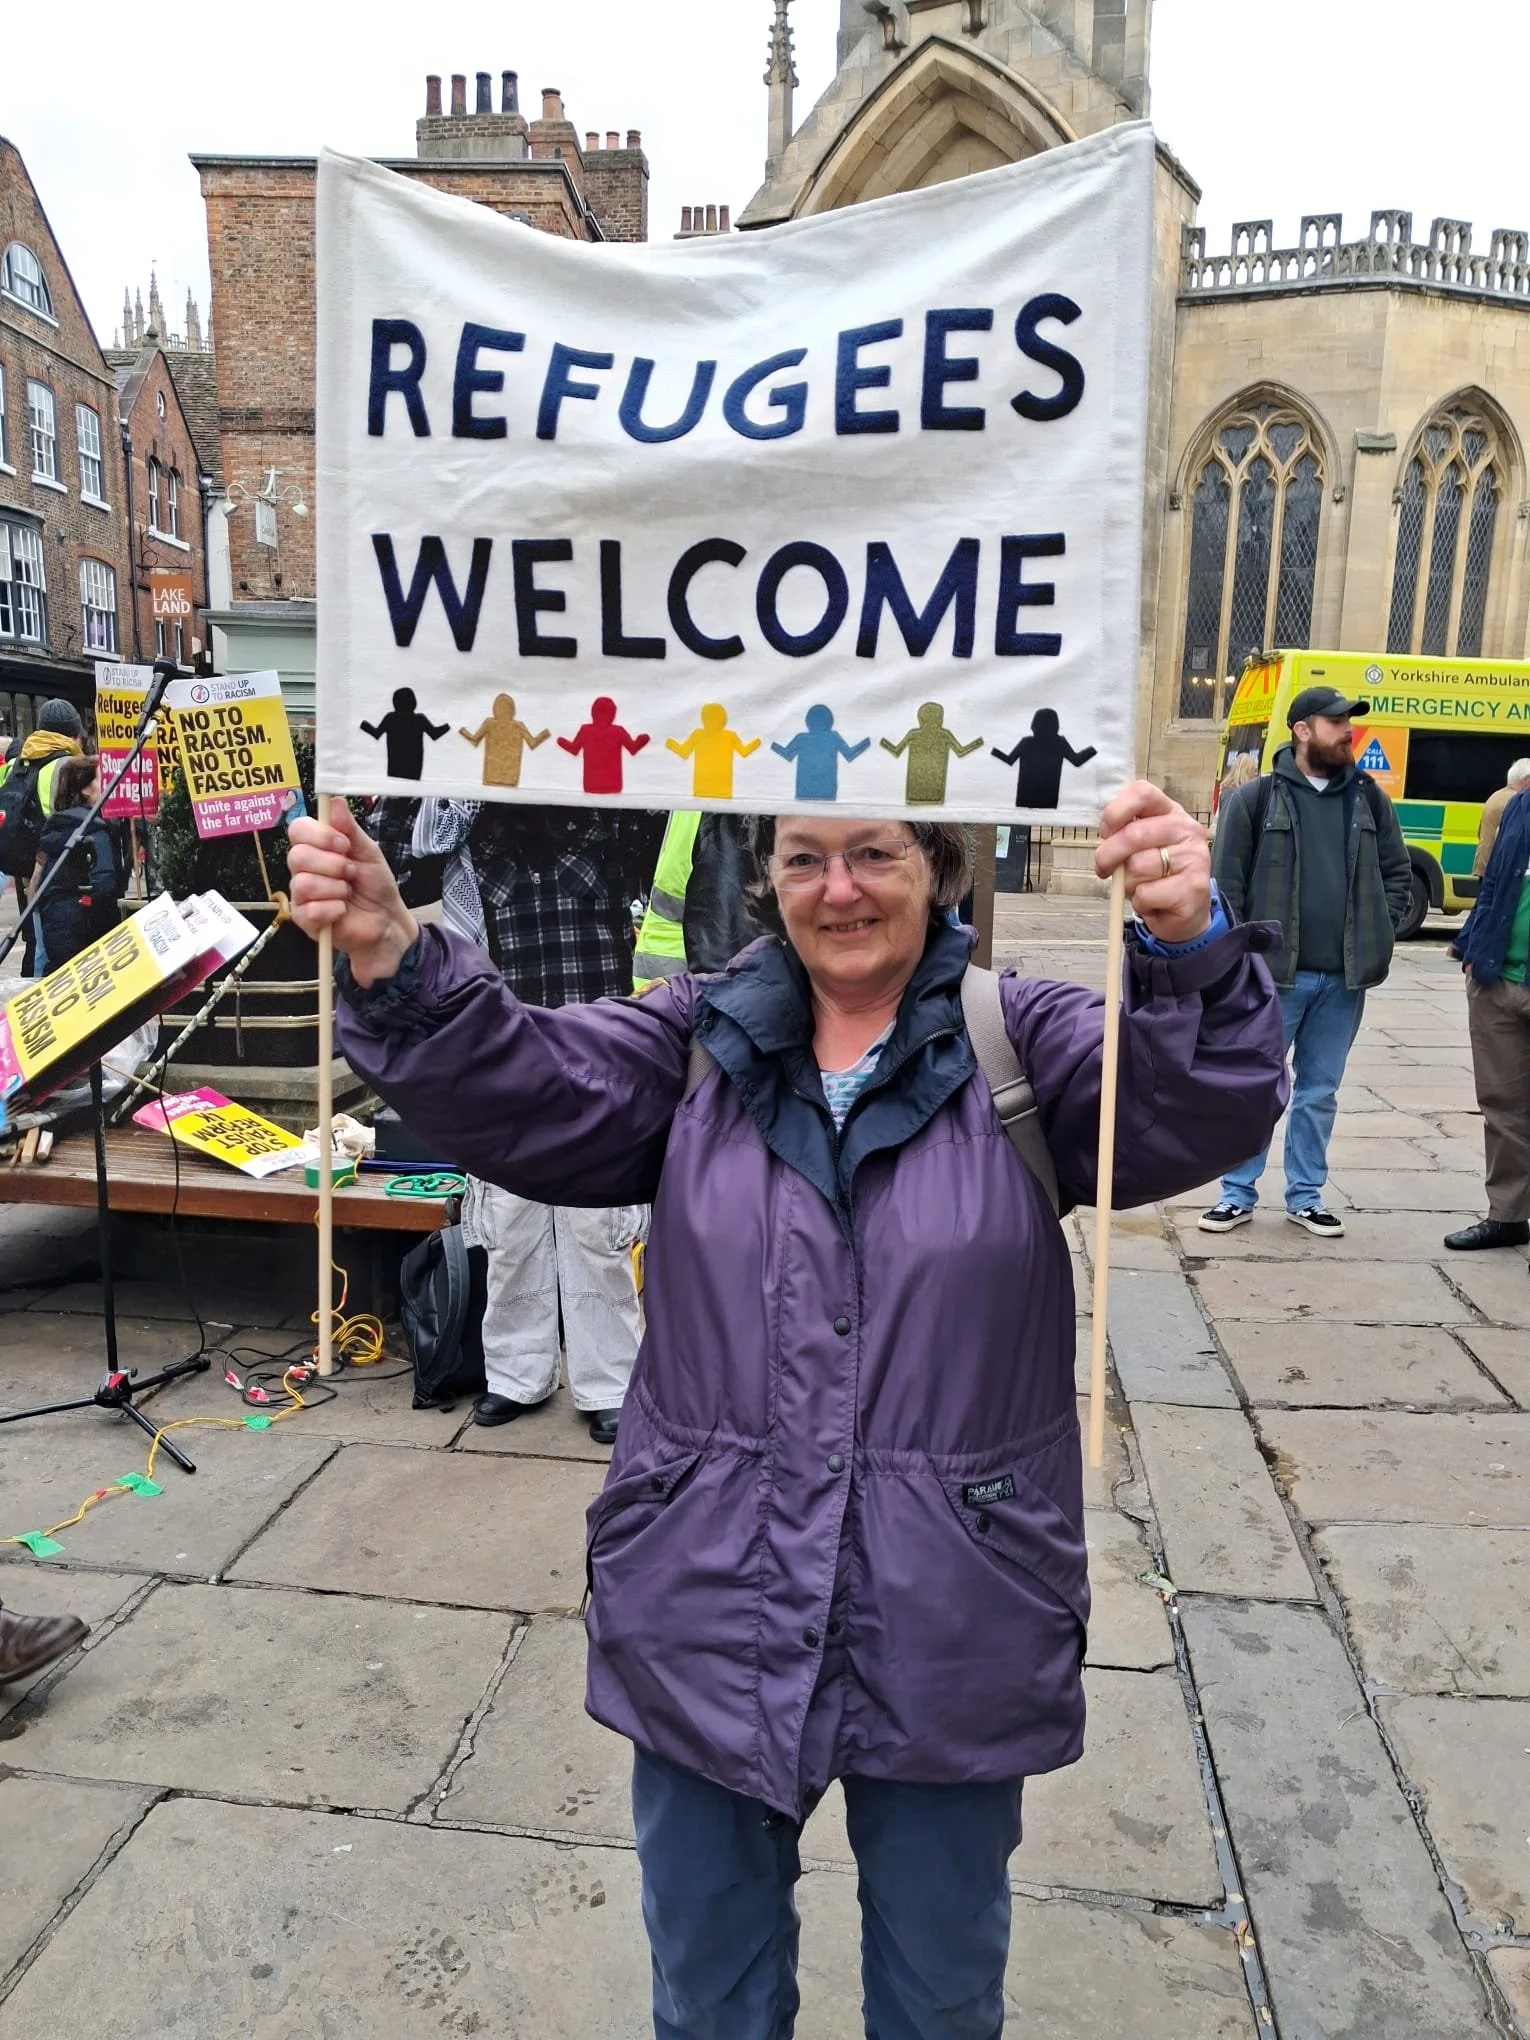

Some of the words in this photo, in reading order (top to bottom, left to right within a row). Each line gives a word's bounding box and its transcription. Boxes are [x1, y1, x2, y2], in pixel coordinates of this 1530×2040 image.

[368, 293, 1086, 443] REFUGEES
[153, 588, 185, 601] LAKE
[371, 532, 1067, 659] WELCOME
[153, 601, 191, 614] LAND
[210, 682, 236, 693] STAND
[237, 679, 250, 689] UP
[1390, 668, 1460, 684] Yorkshire
[97, 692, 146, 719] Refuge
[212, 692, 224, 701] TO
[224, 687, 256, 700] RACISM
[100, 719, 152, 740] welco
[179, 710, 210, 733] NO
[213, 705, 243, 728] TO
[183, 724, 272, 754] RACISM,
[188, 752, 220, 775] NO
[224, 747, 253, 769] TO
[1363, 755, 1384, 769] 111
[119, 777, 154, 803] right
[192, 763, 285, 795] FASCISM
[199, 799, 231, 815] Unite
[234, 792, 277, 810] against
[201, 817, 222, 830] the
[225, 814, 241, 827] far
[245, 808, 273, 825] right
[51, 985, 80, 1017] O
